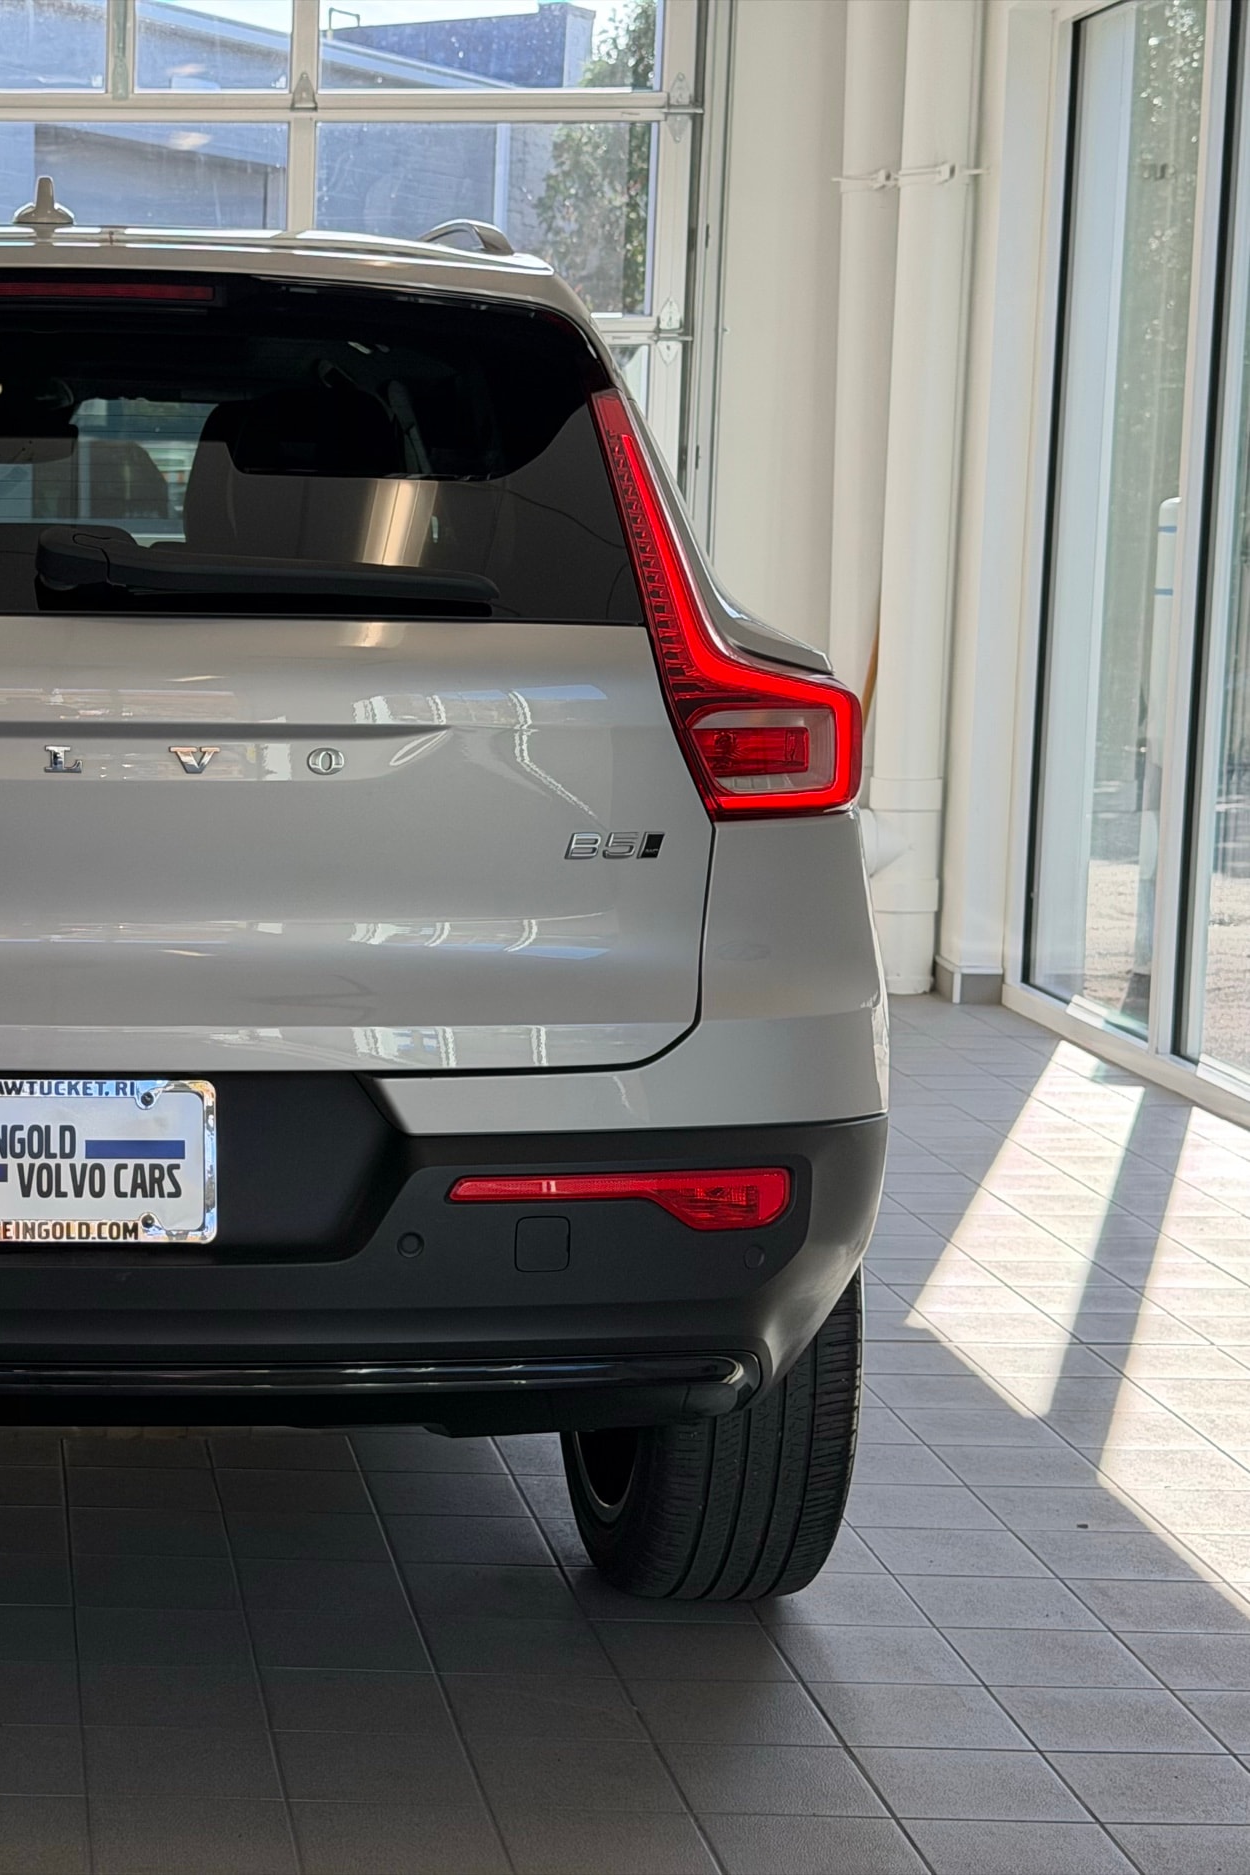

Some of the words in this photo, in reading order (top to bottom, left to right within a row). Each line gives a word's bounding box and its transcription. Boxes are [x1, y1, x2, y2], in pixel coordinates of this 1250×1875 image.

[564, 831, 638, 859] B5
[116, 1080, 135, 1096] RI
[17, 1163, 106, 1198] VOLVO
[114, 1163, 182, 1198] CARS
